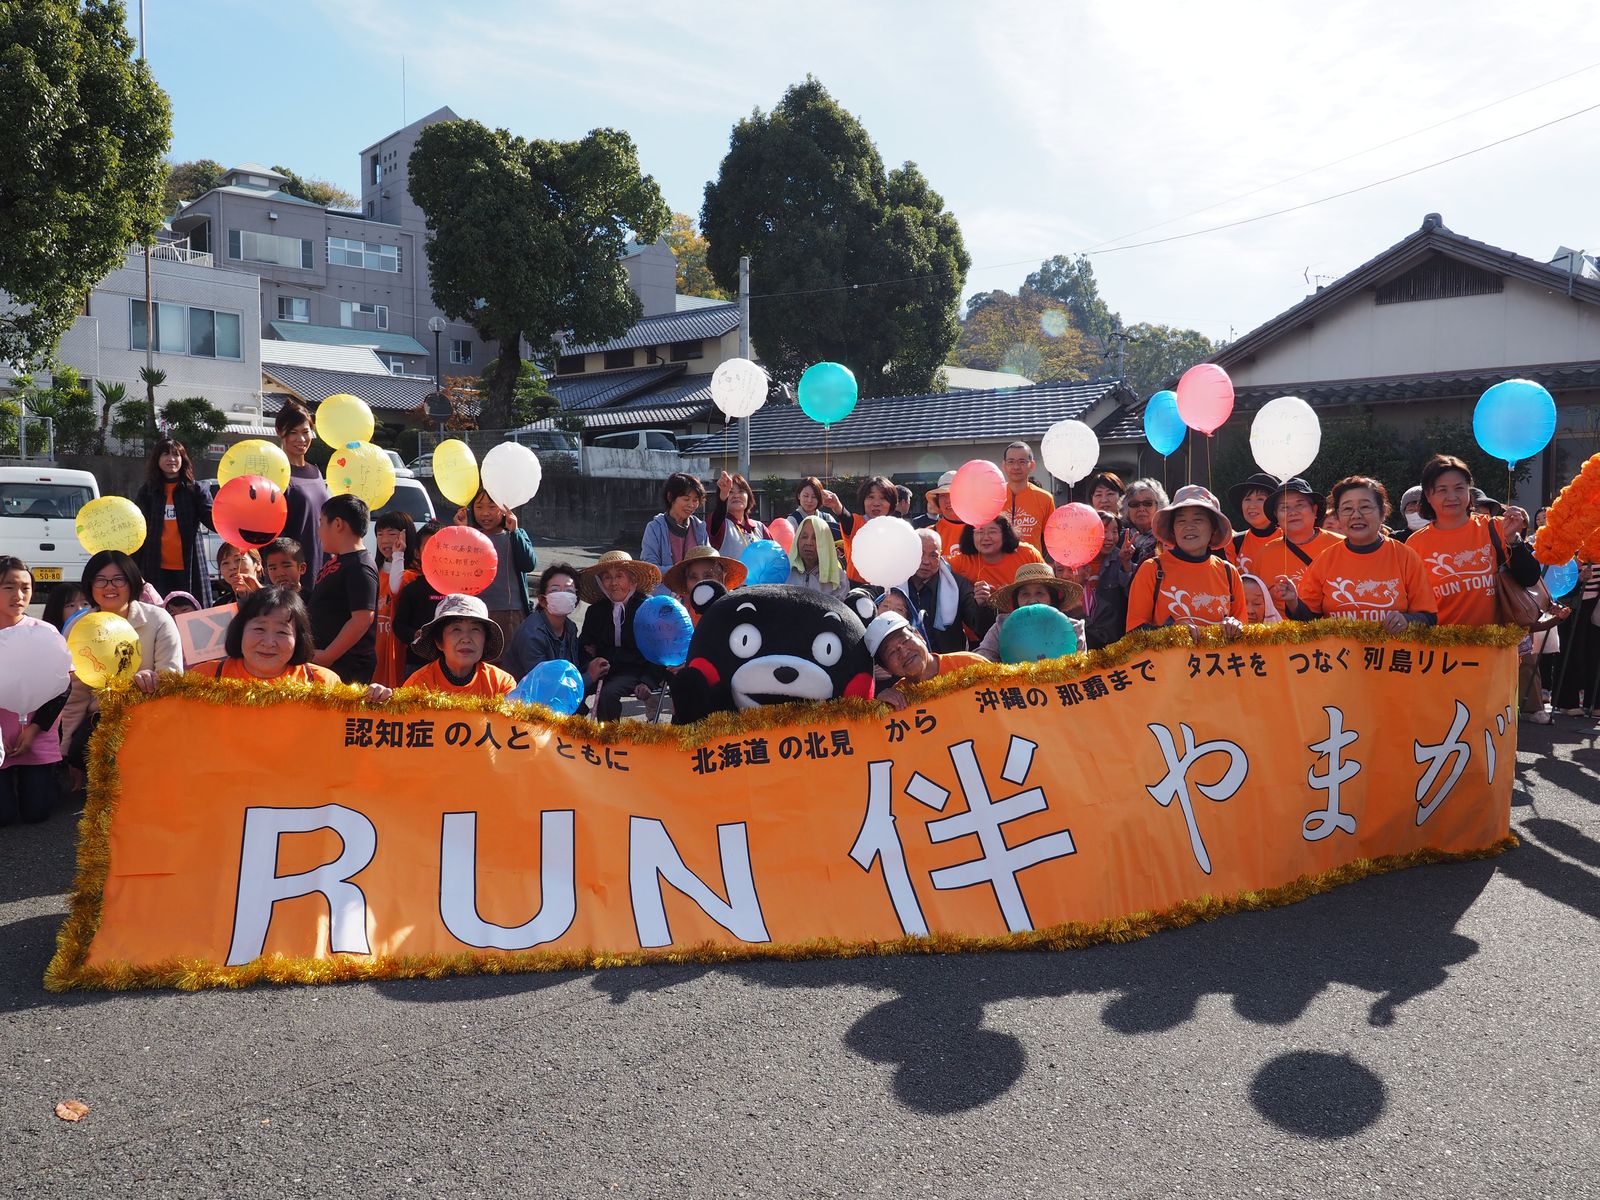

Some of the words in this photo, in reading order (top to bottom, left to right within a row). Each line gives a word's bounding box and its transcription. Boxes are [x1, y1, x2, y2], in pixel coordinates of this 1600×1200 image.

[1433, 581, 1461, 599] RUN
[1330, 610, 1357, 622] RUN
[556, 736, 630, 772] ともに
[885, 708, 937, 743] から
[1187, 652, 1268, 679] タスキを
[1289, 647, 1351, 675] つなぐ
